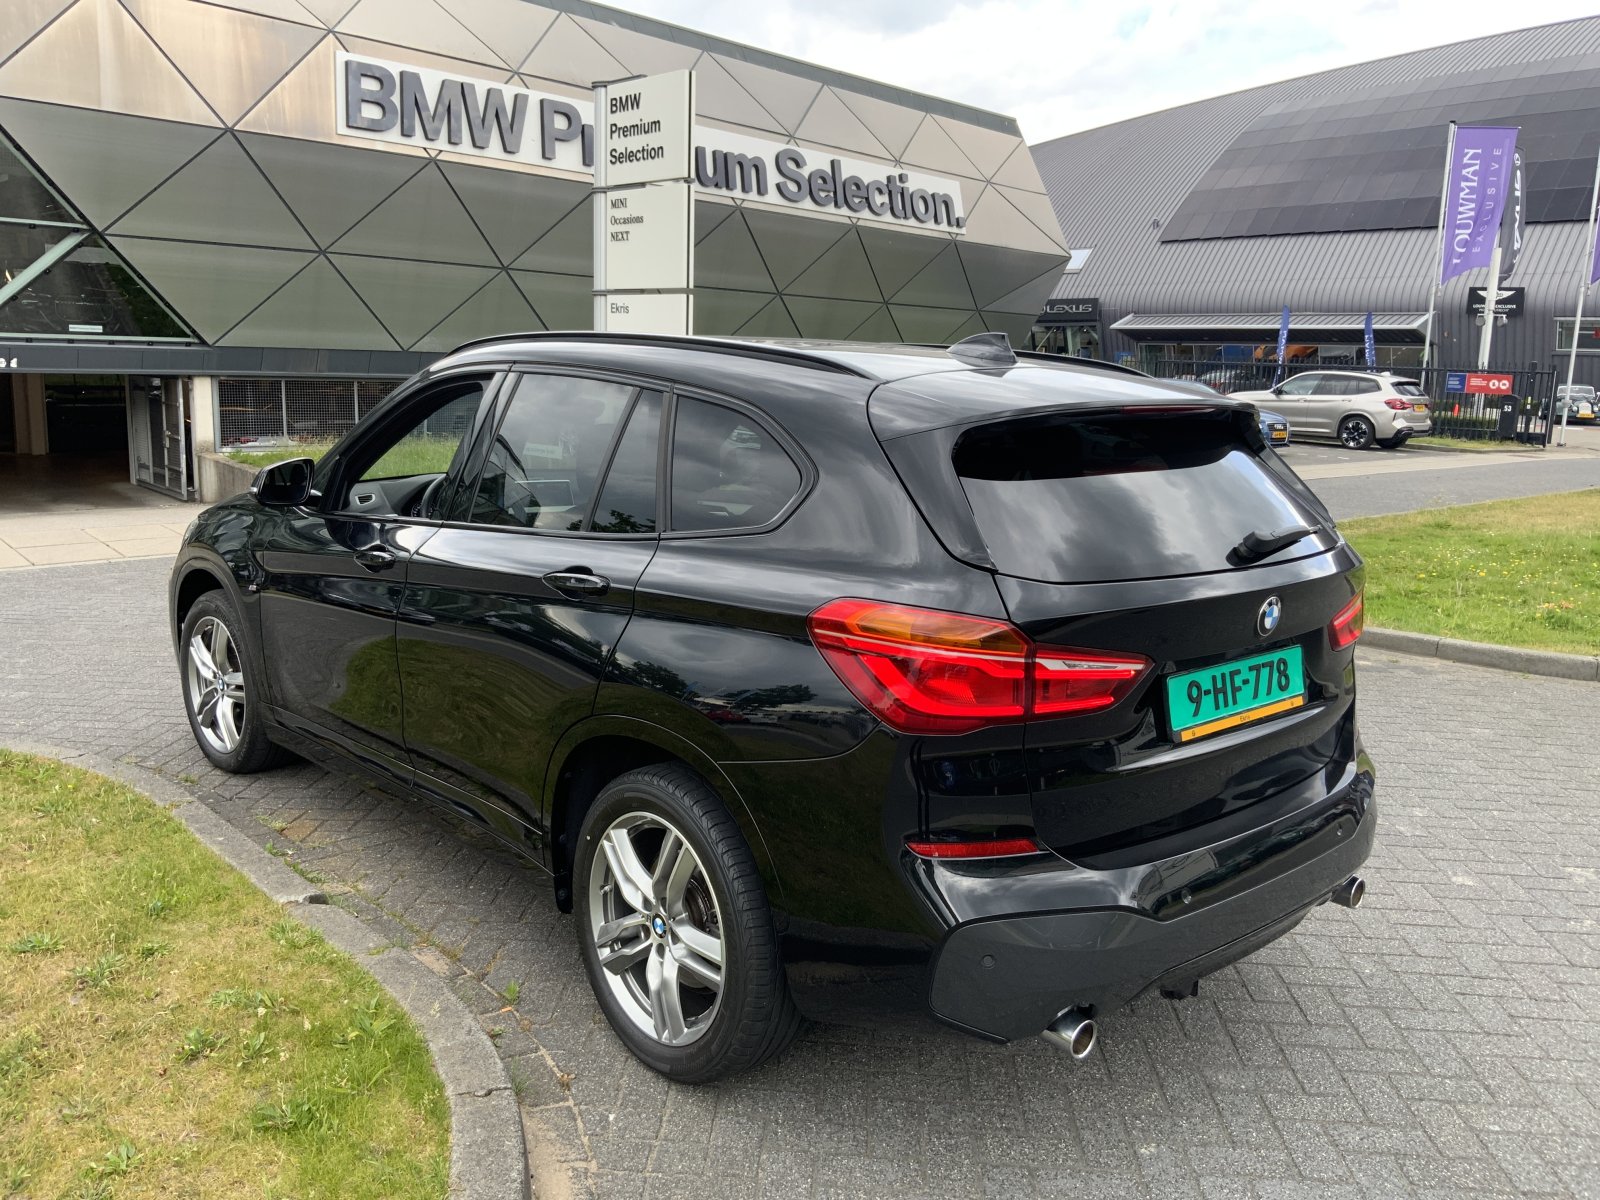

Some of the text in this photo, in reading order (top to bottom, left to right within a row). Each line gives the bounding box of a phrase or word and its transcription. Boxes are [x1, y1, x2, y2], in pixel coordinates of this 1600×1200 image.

[610, 92, 642, 114] BMW
[609, 118, 661, 140] Premium
[344, 59, 529, 154] BMW
[775, 148, 967, 228] Selection.
[609, 144, 664, 165] Selection
[610, 197, 628, 210] MINI
[610, 214, 644, 226] Occasions
[610, 230, 630, 242] NEXT
[610, 302, 630, 314] Ekris
[1046, 304, 1093, 314] LEXUS
[1186, 657, 1291, 718] 9-HF-778
